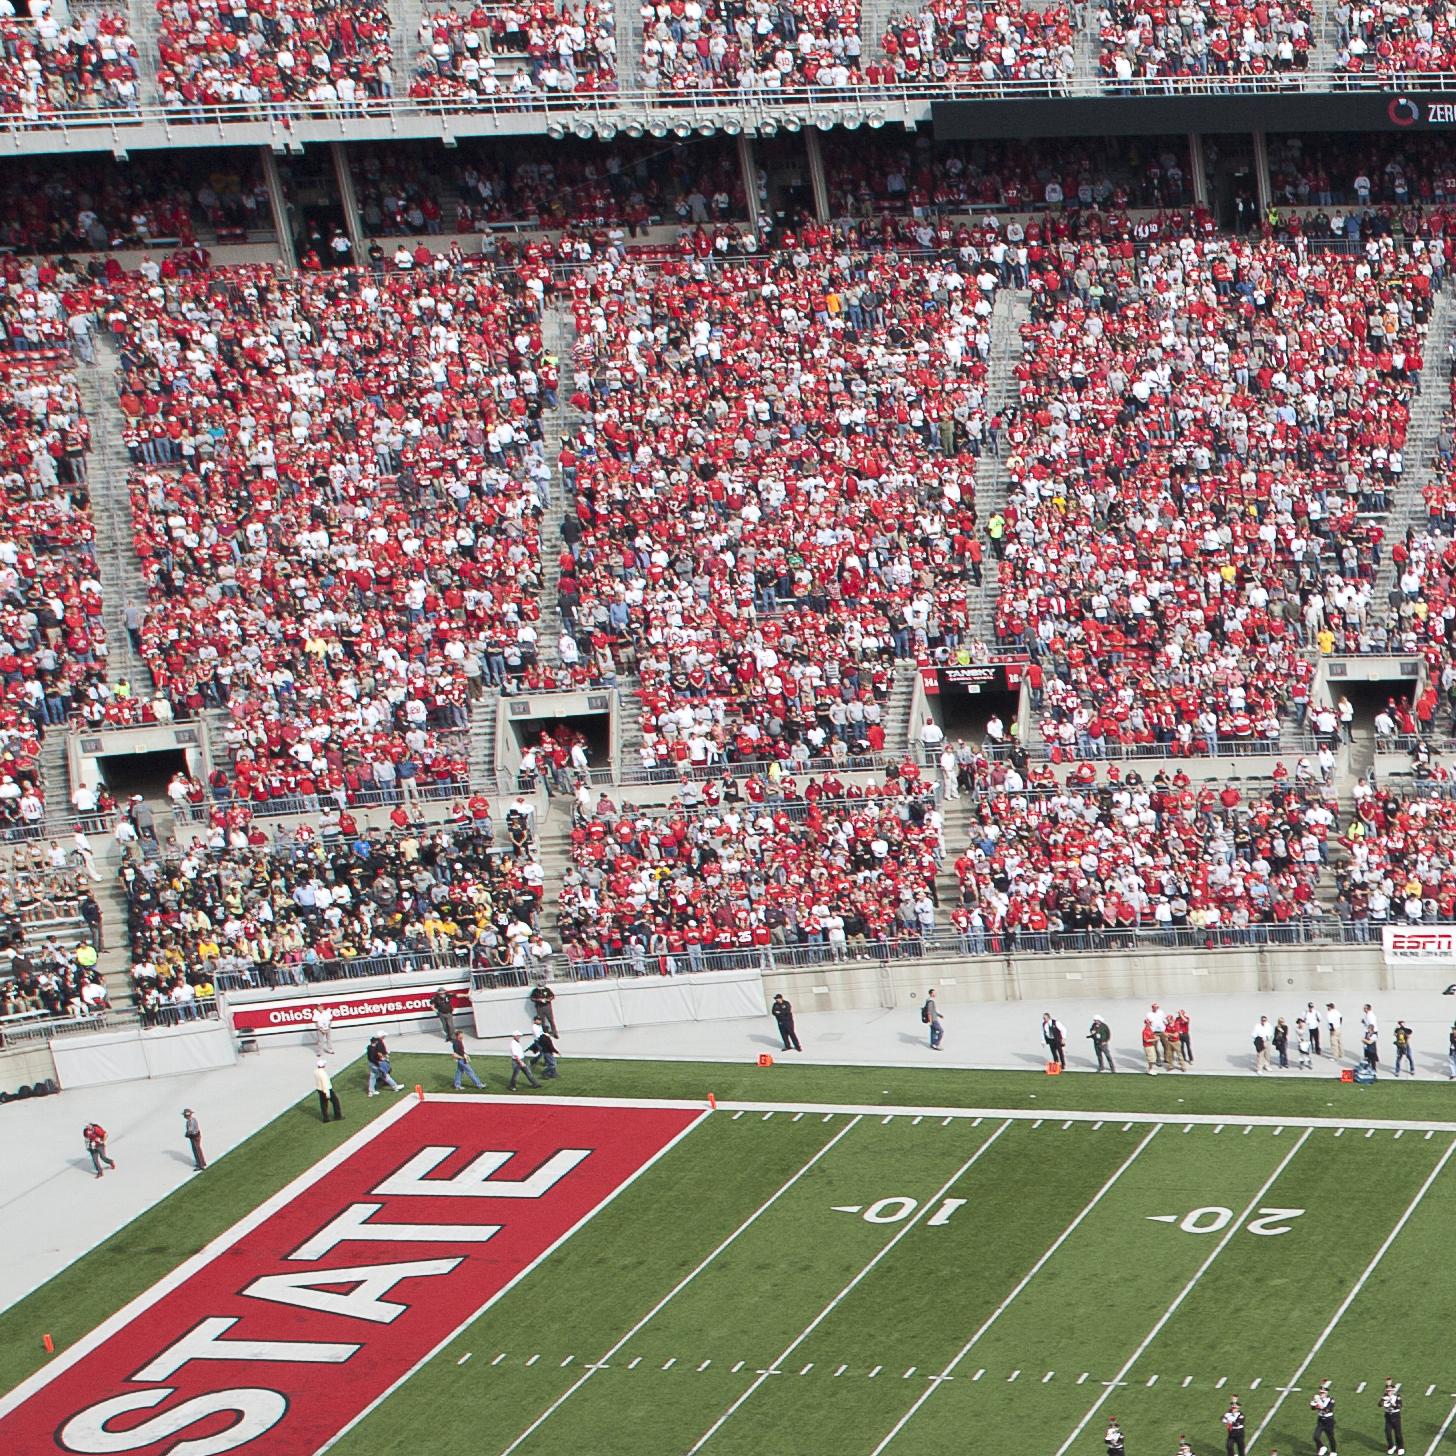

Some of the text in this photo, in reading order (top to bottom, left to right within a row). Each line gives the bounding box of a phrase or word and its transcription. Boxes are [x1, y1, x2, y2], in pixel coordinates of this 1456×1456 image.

[1392, 934, 1452, 950] ESPN
[862, 1195, 968, 1226] 10
[1178, 1206, 1306, 1237] 20
